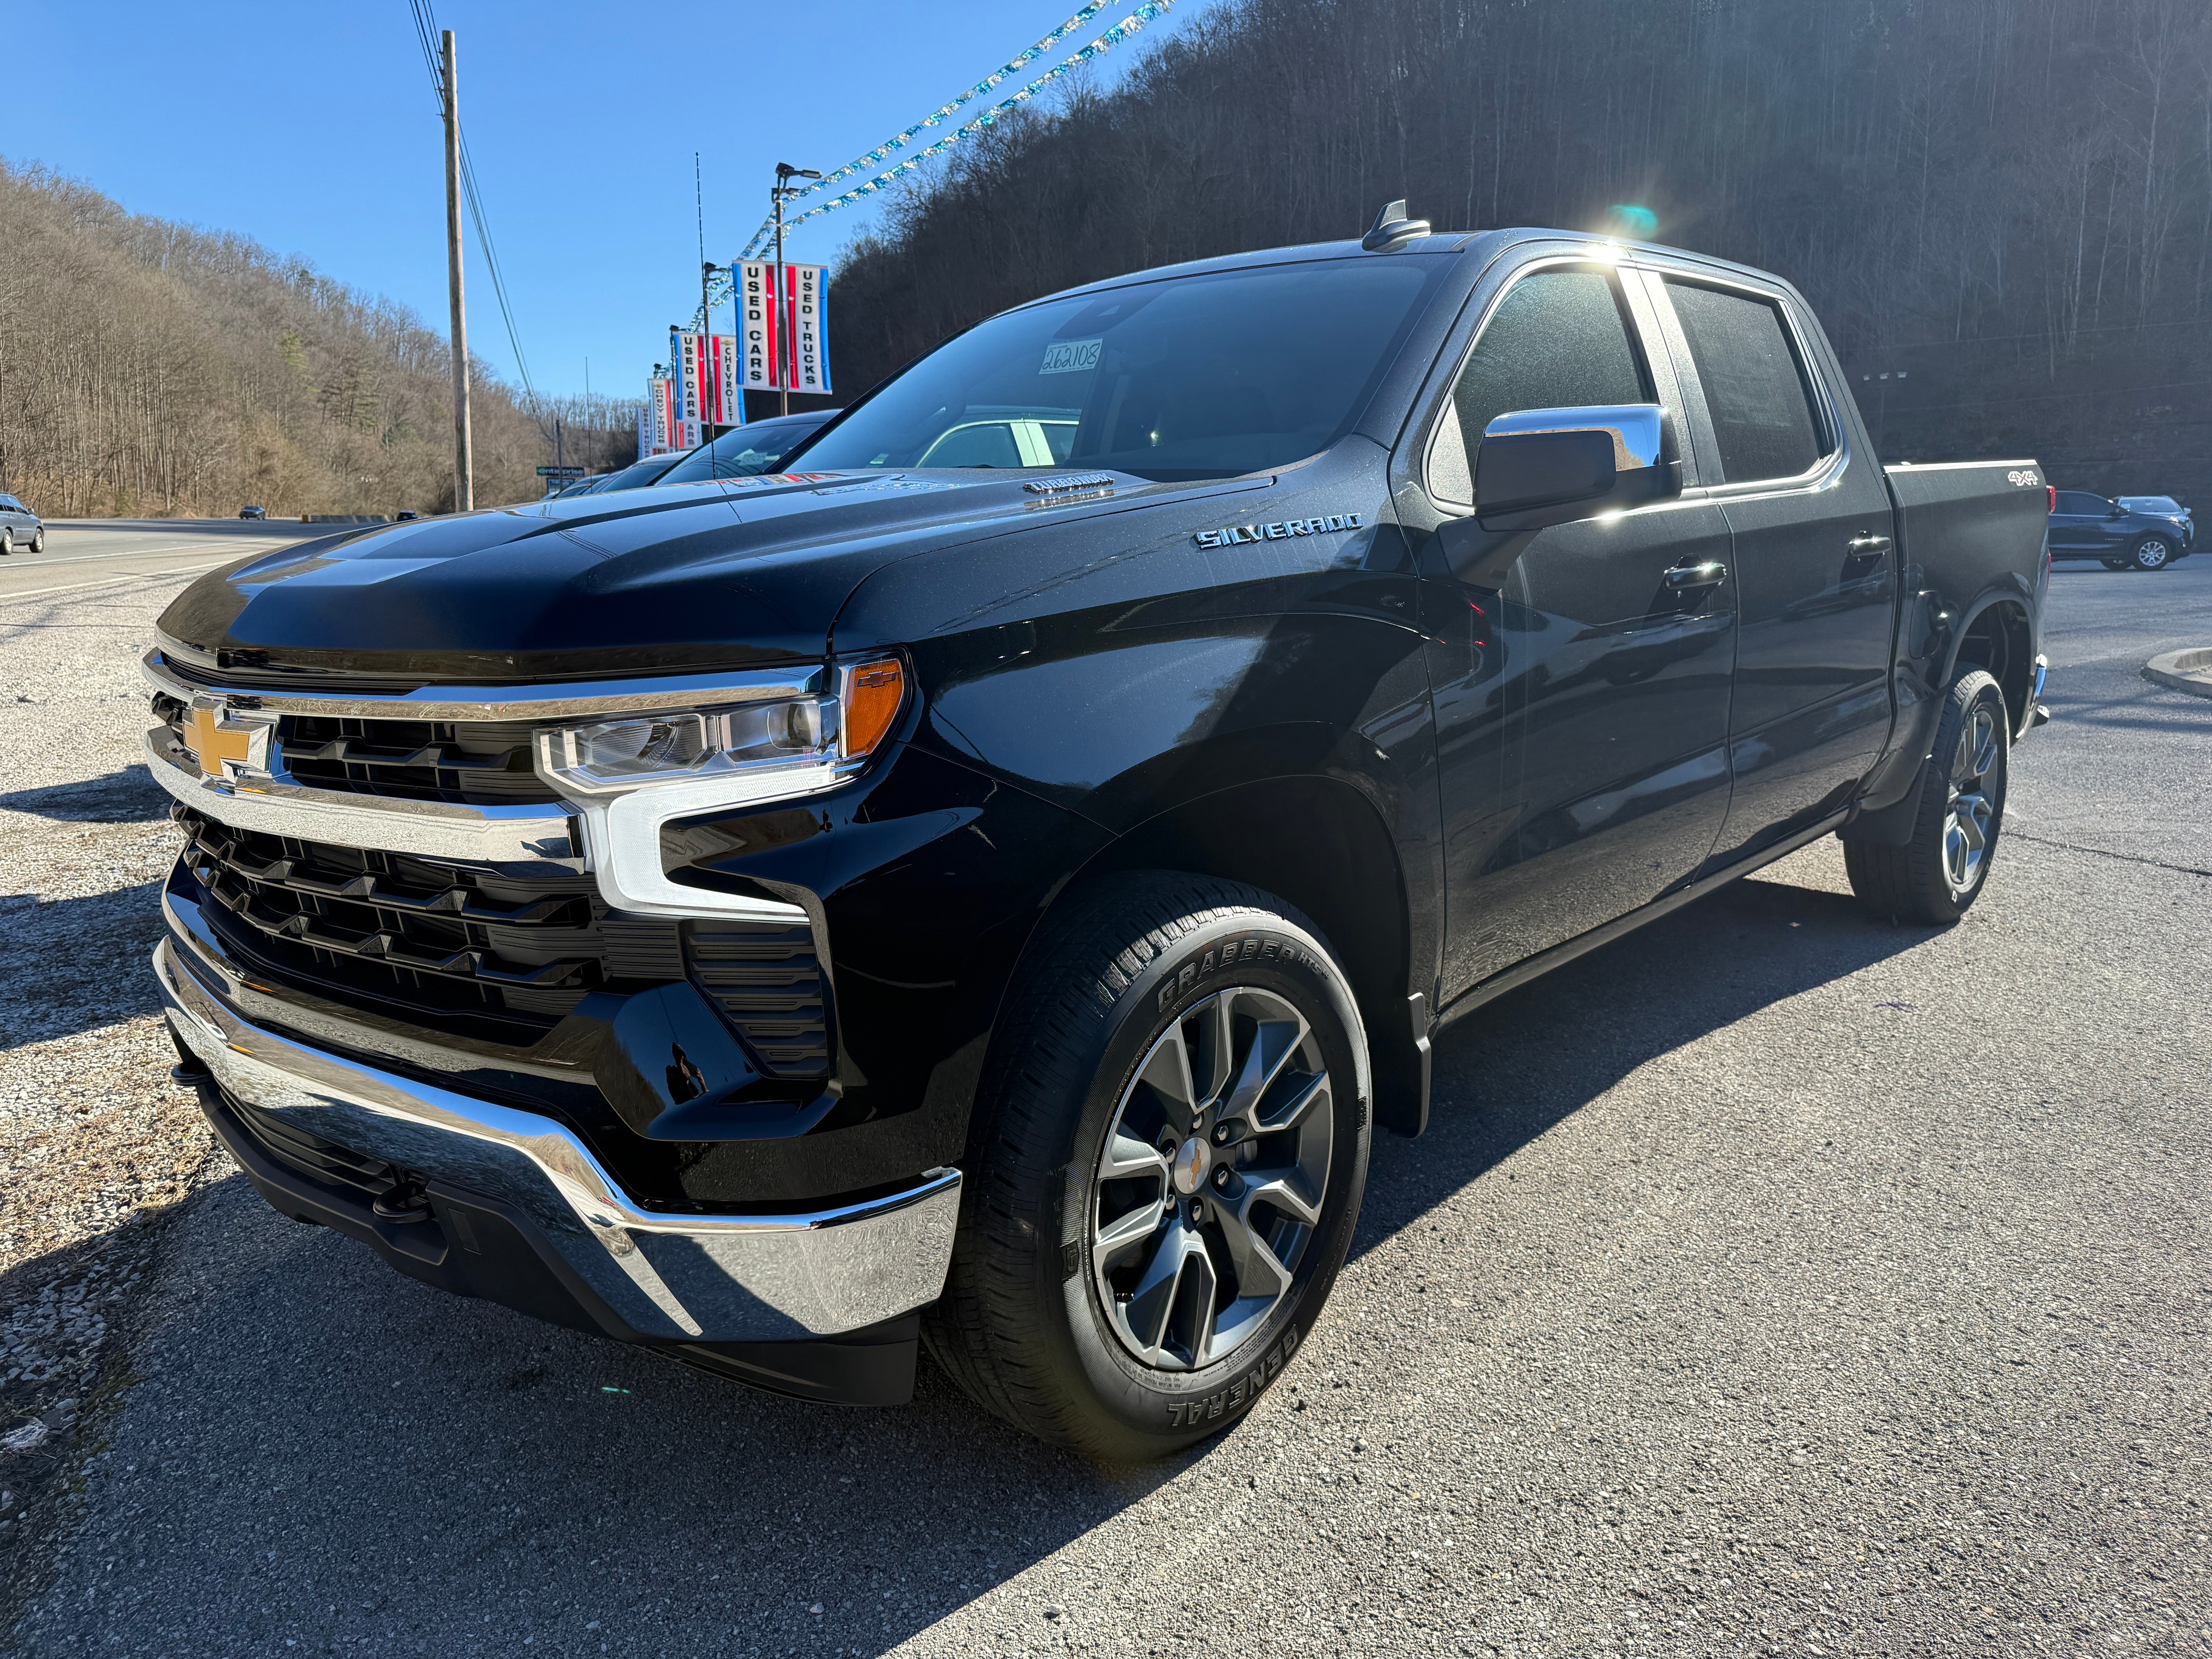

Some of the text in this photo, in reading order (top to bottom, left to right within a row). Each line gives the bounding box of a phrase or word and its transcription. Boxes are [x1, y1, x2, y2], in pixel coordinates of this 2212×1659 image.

[748, 267, 762, 381] USED CARS
[803, 271, 815, 384] USED TRUCKS
[1042, 342, 1100, 370] 262108
[656, 389, 664, 412] CHEVY
[685, 337, 695, 417] USED CARS
[725, 347, 733, 421] CHEVROLET
[1023, 473, 1115, 495] TURBOMAX
[1194, 512, 1364, 550] SILVERADO
[1158, 940, 1296, 1012] GRABBER
[1167, 1324, 1298, 1426] GENERAL
